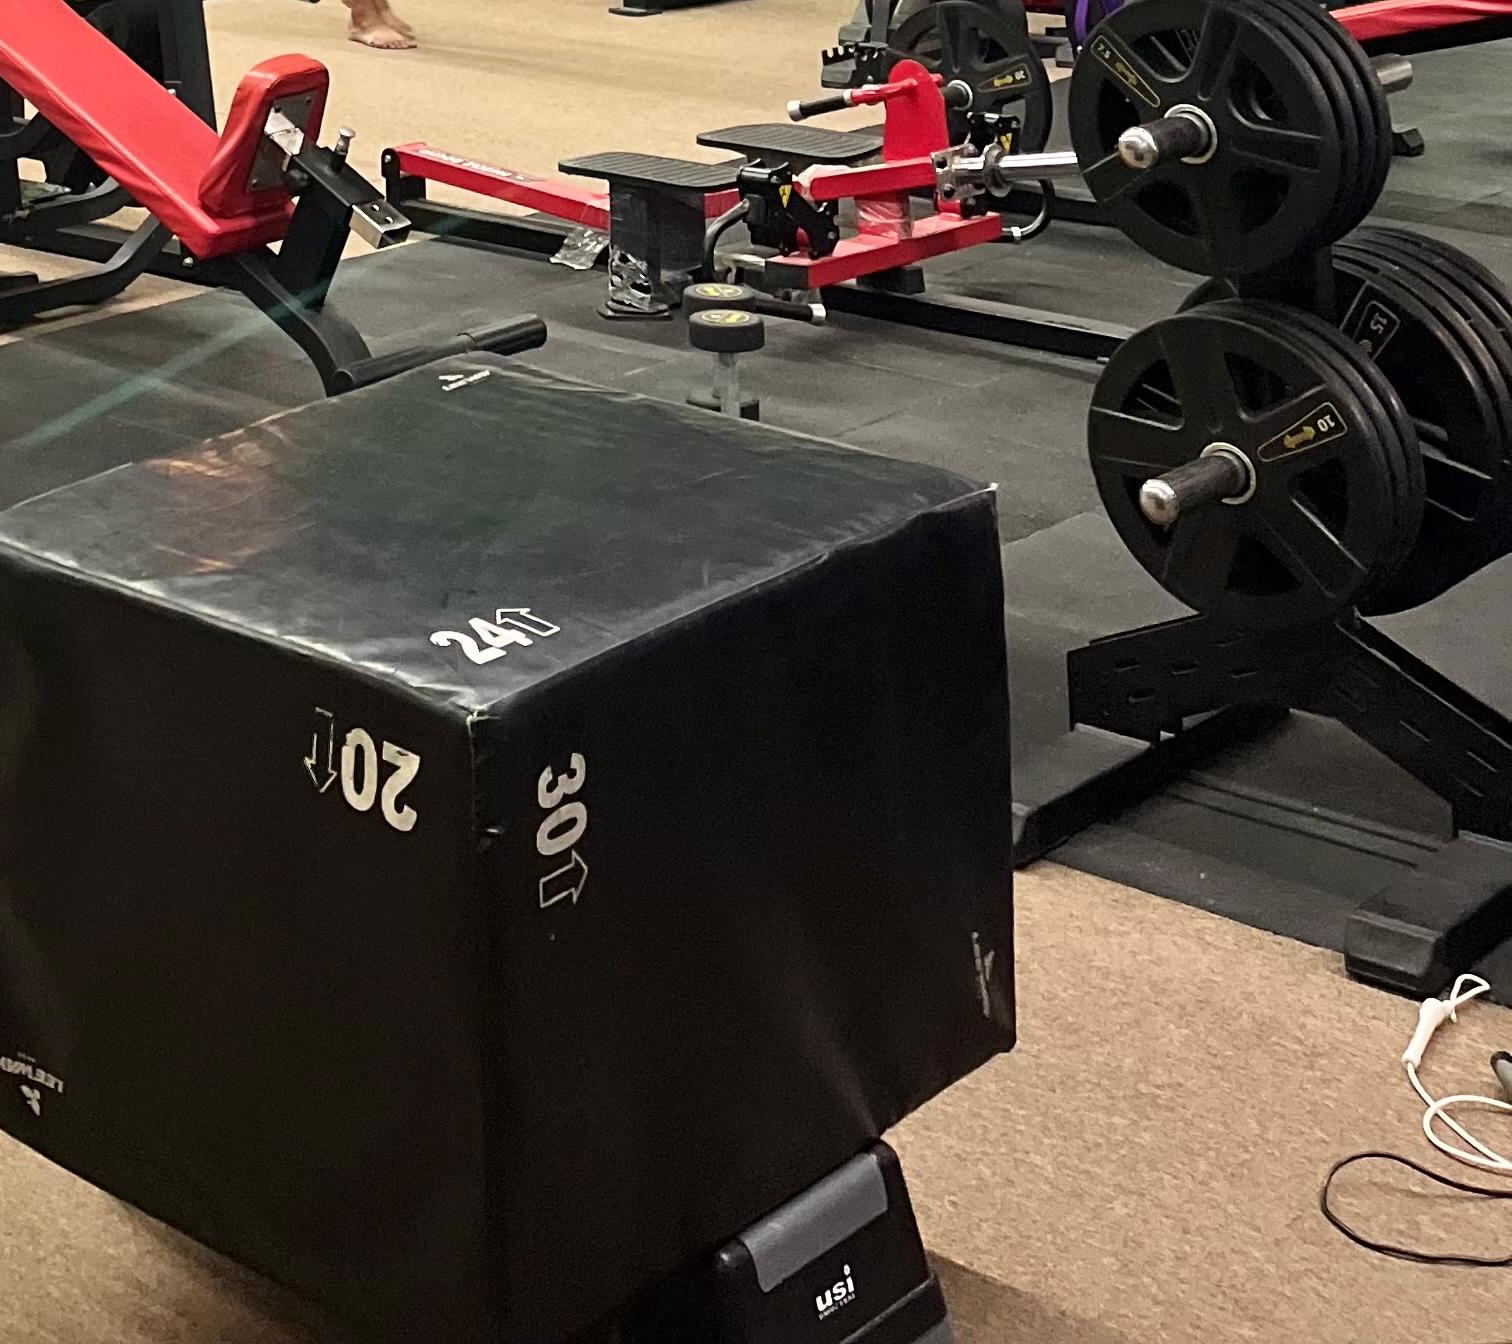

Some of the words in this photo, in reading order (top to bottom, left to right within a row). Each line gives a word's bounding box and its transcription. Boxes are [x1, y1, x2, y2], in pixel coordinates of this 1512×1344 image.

[1369, 312, 1388, 335] 15
[1316, 414, 1336, 432] 10
[429, 617, 534, 665] 24
[341, 727, 421, 832] 20
[536, 752, 588, 856] 30
[815, 1263, 855, 1312] usi
